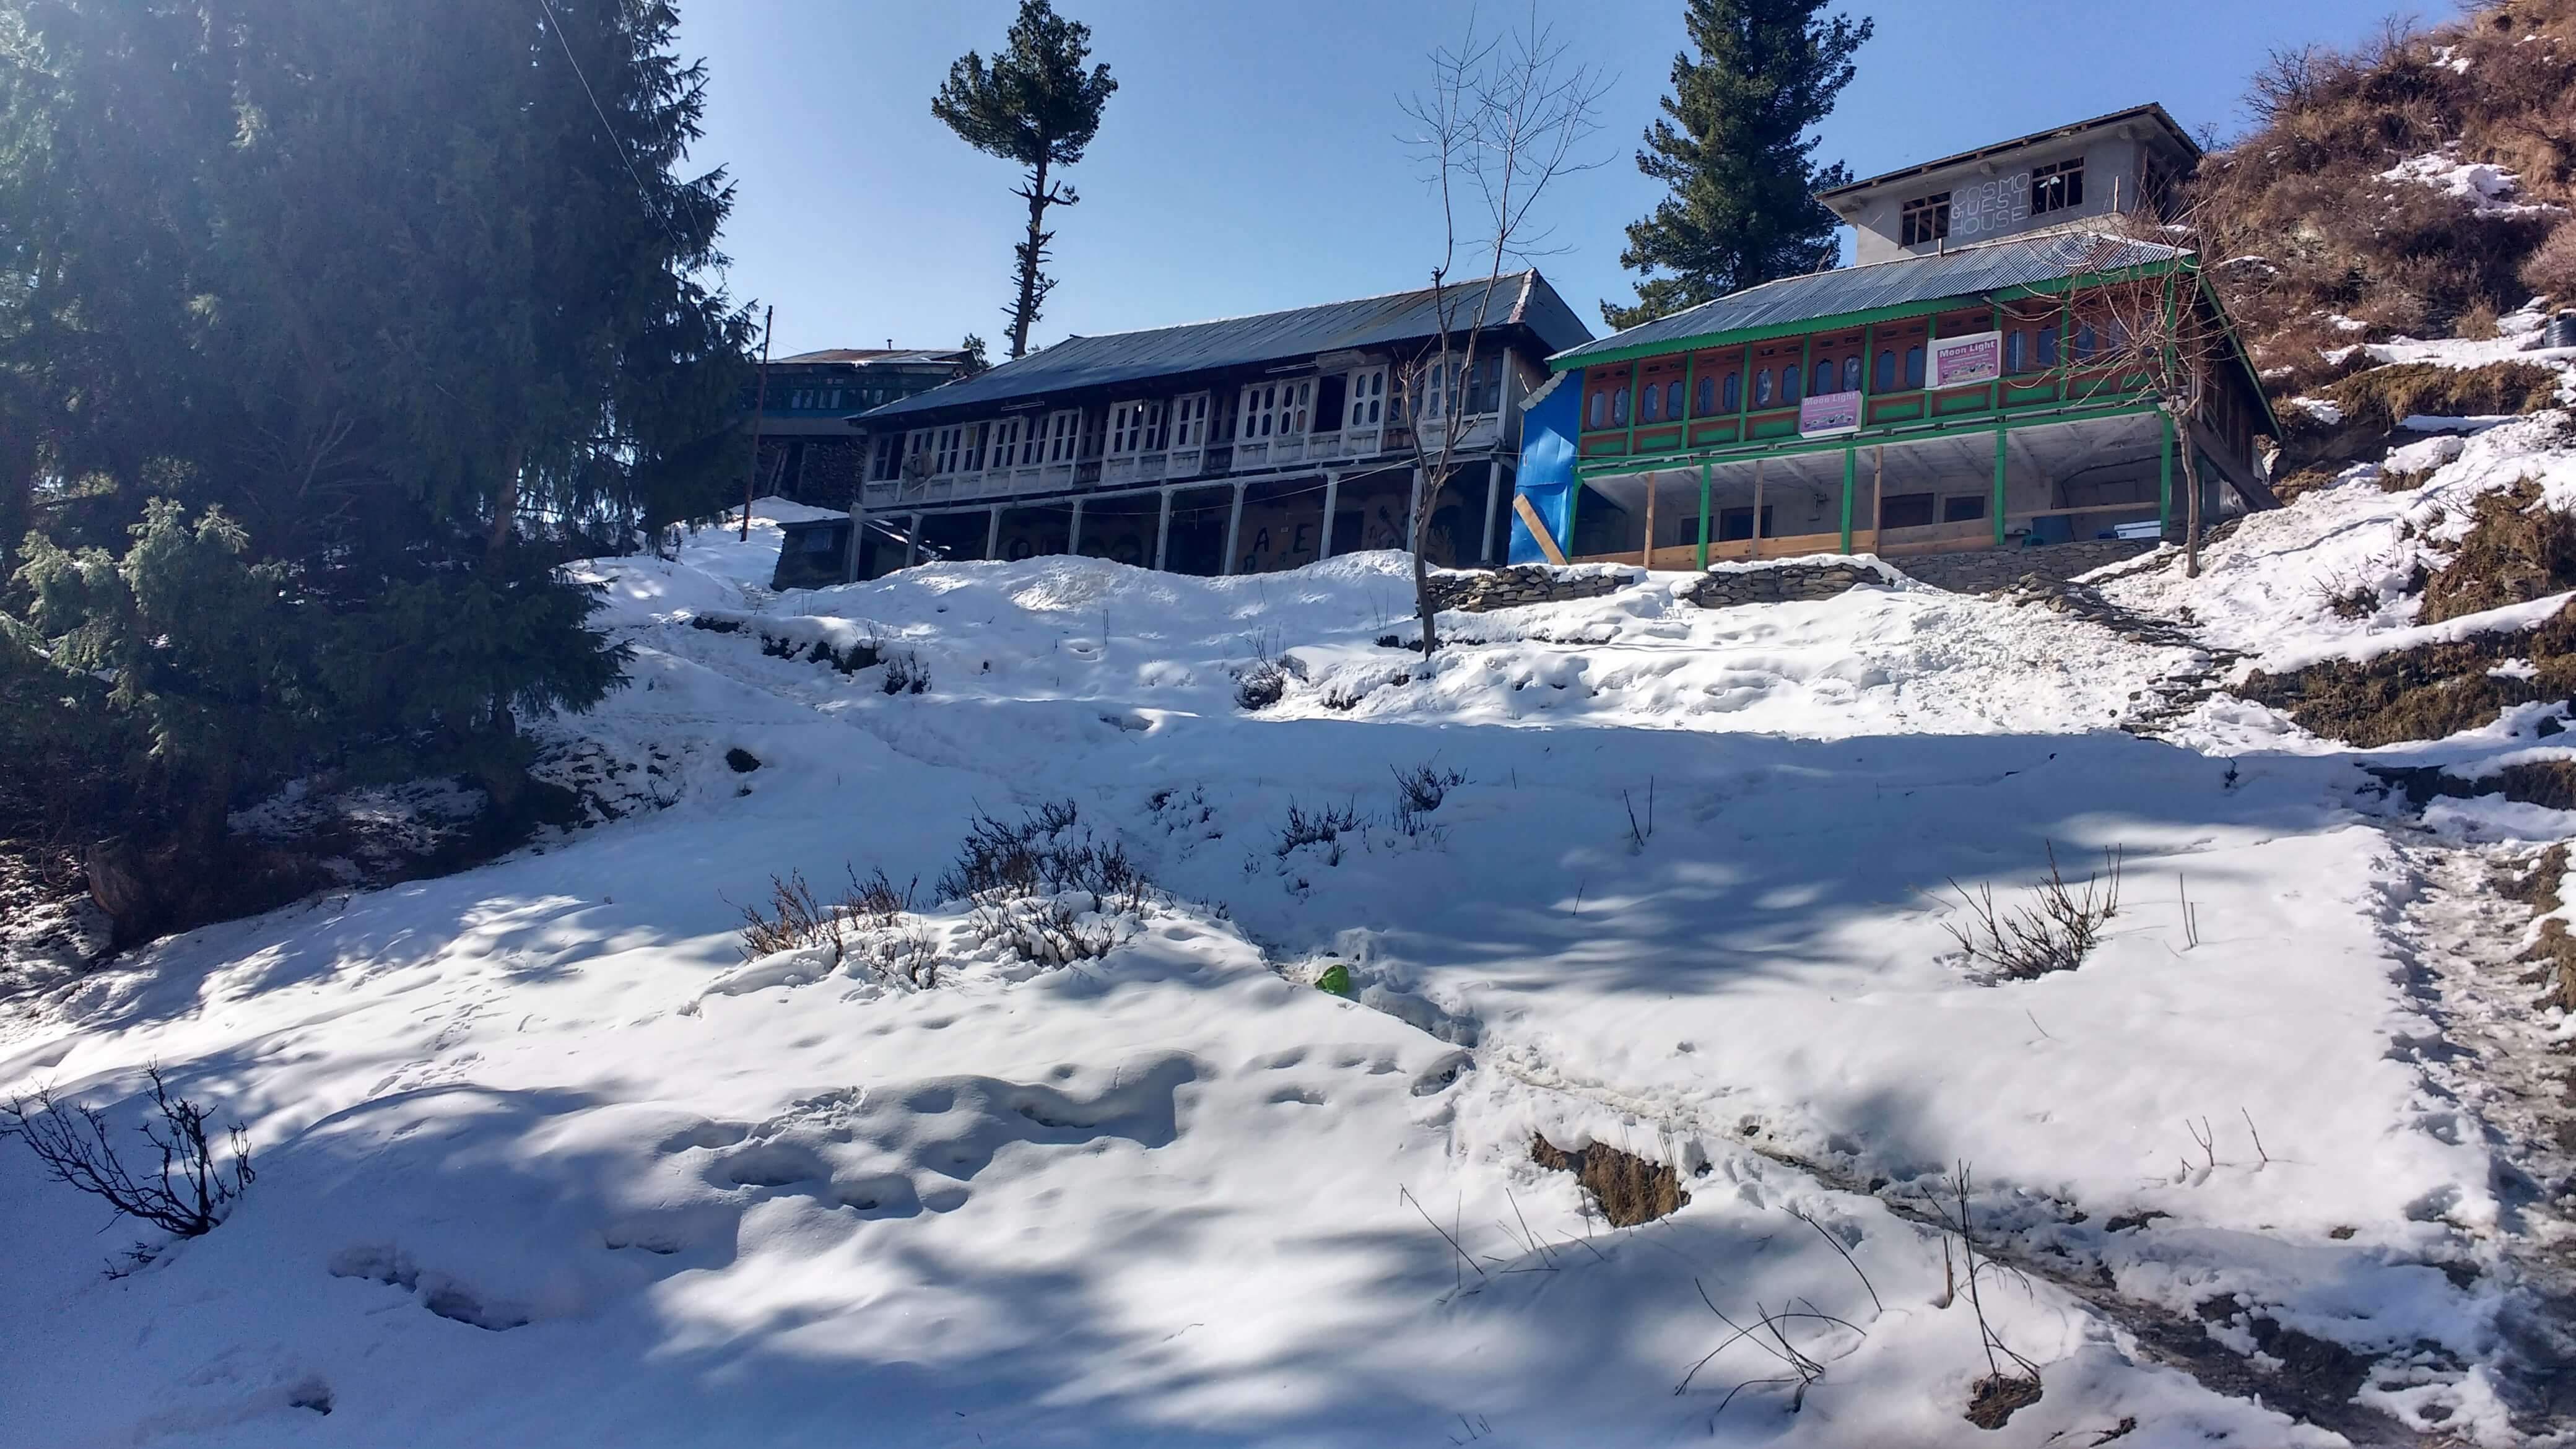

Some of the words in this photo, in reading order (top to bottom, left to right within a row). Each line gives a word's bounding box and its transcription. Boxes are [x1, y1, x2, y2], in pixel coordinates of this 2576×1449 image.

[1951, 188, 2027, 219] GUEST
[1952, 173, 2030, 206] COSMO
[1951, 205, 2028, 238] HOUSE
[1939, 347, 1966, 358] Moon
[1970, 341, 1995, 352] Light
[1804, 398, 1829, 406] Moon
[1833, 393, 1856, 402] Light
